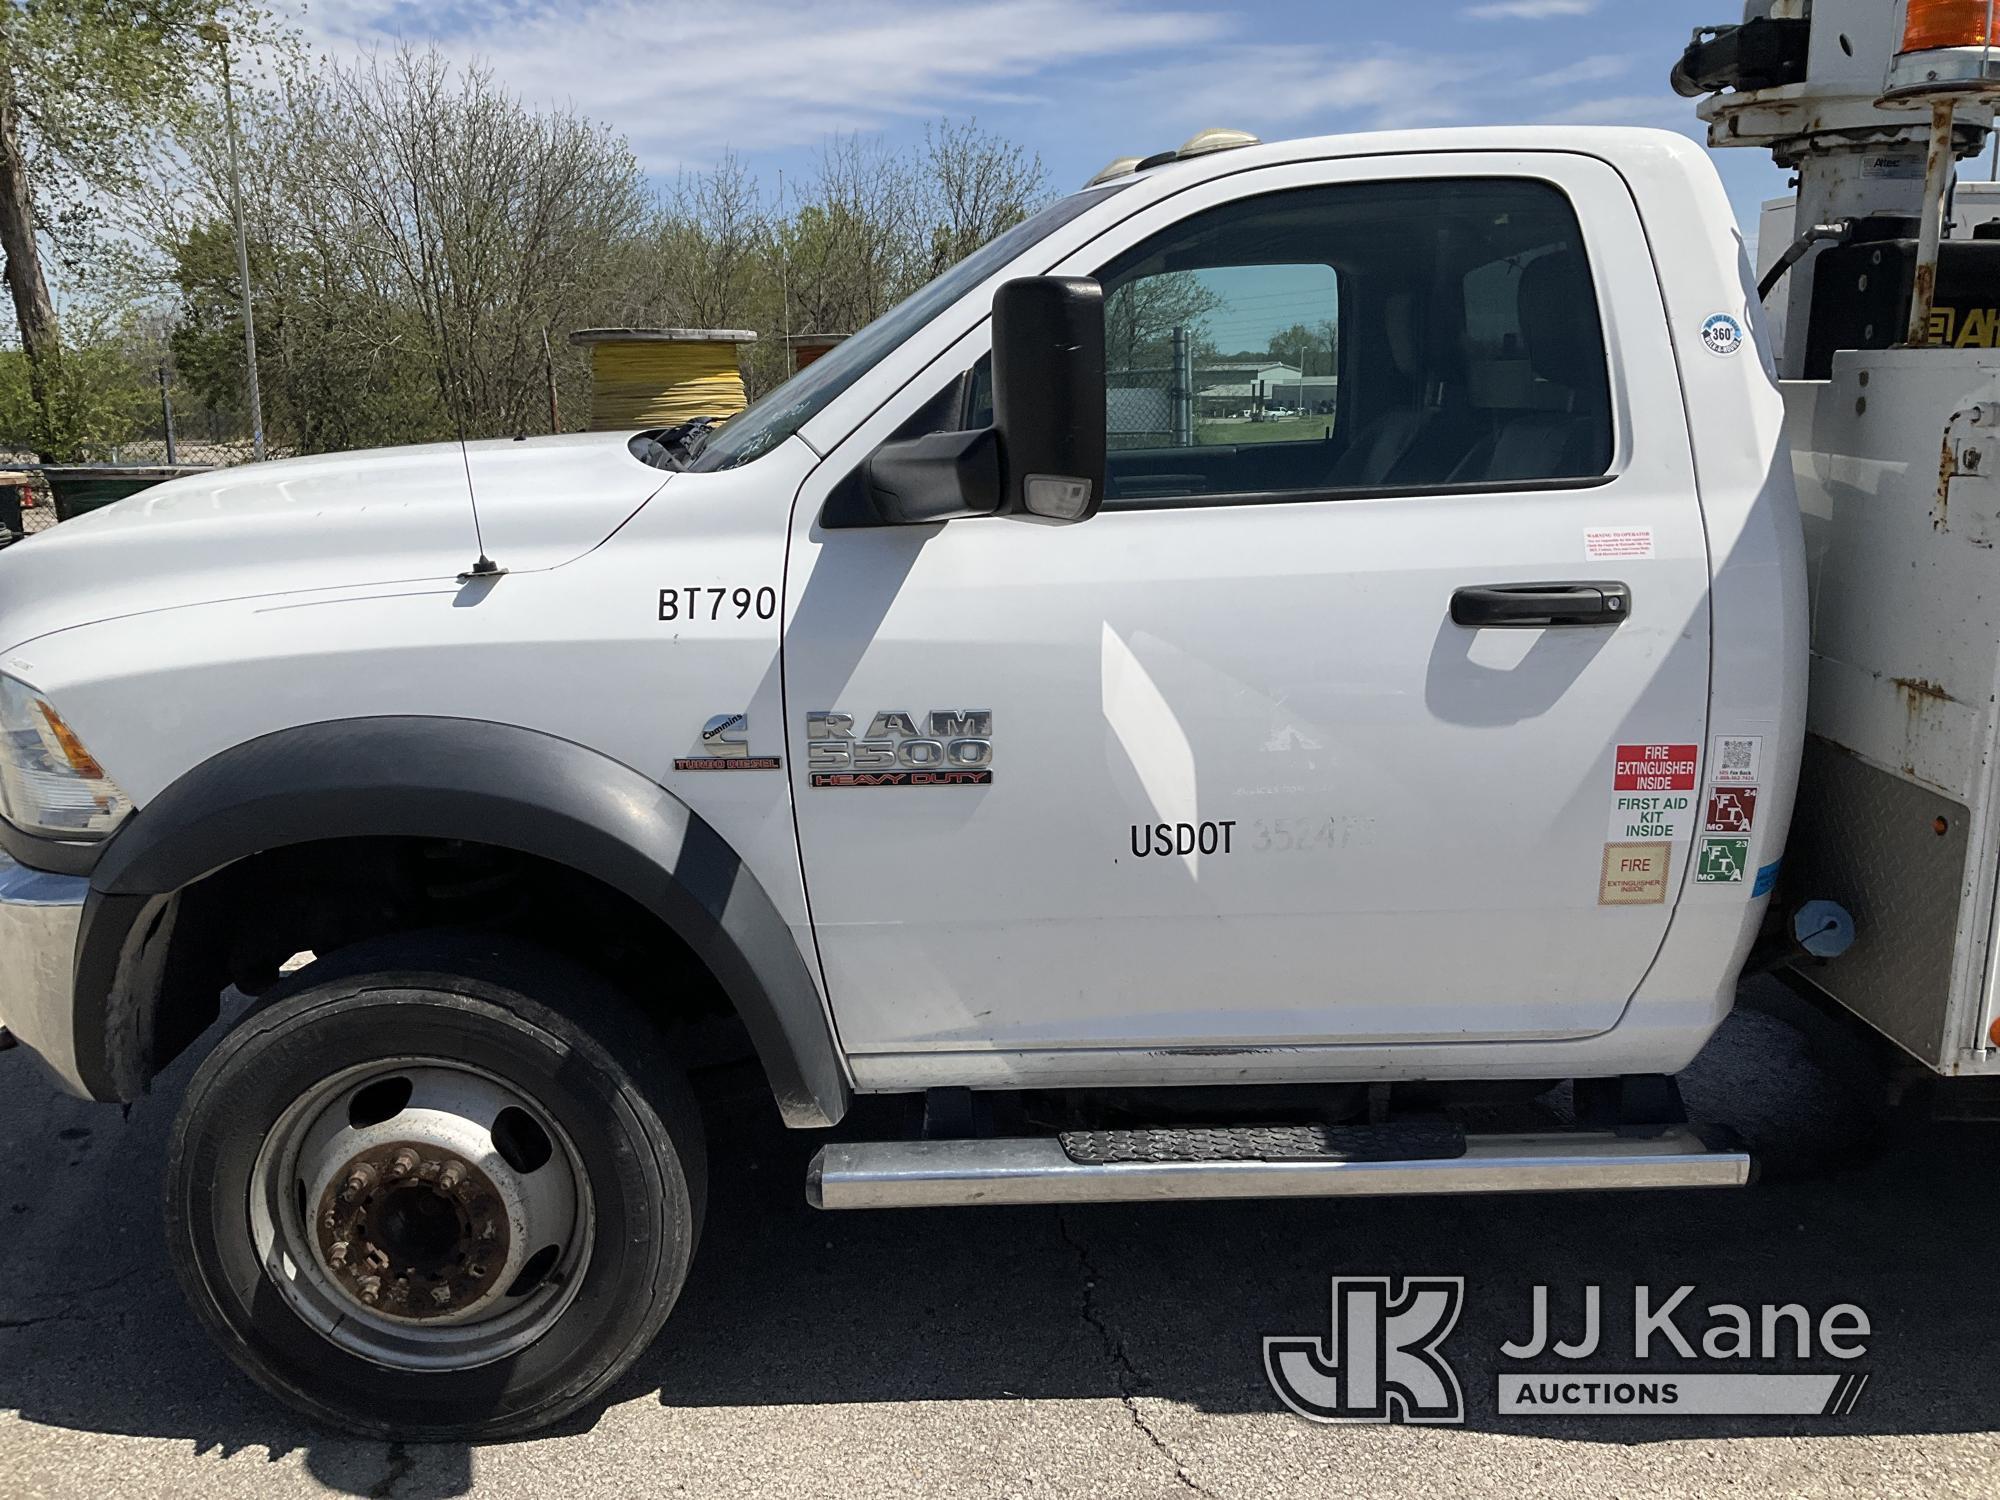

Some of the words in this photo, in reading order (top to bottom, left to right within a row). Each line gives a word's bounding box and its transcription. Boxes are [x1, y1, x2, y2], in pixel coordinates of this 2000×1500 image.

[658, 586, 776, 621] BT790
[702, 713, 743, 740] Cummins
[806, 709, 993, 740] RAM
[807, 739, 993, 769] 5500
[1645, 746, 1669, 760] FIRE
[676, 759, 725, 770] TURBO
[727, 759, 779, 769] DIESEL
[1616, 761, 1694, 775] EXTINGUISHER
[815, 773, 906, 786] HEAVY
[911, 772, 987, 785] DUTY
[1636, 776, 1672, 790] INSIDE
[1618, 798, 1660, 810] FIRST
[1663, 798, 1688, 810] AID
[1640, 811, 1664, 823] KIT
[1626, 825, 1674, 836] INSIDE
[1706, 823, 1723, 831] MO
[1131, 820, 1236, 858] USDOT
[1620, 859, 1651, 872] FIRE
